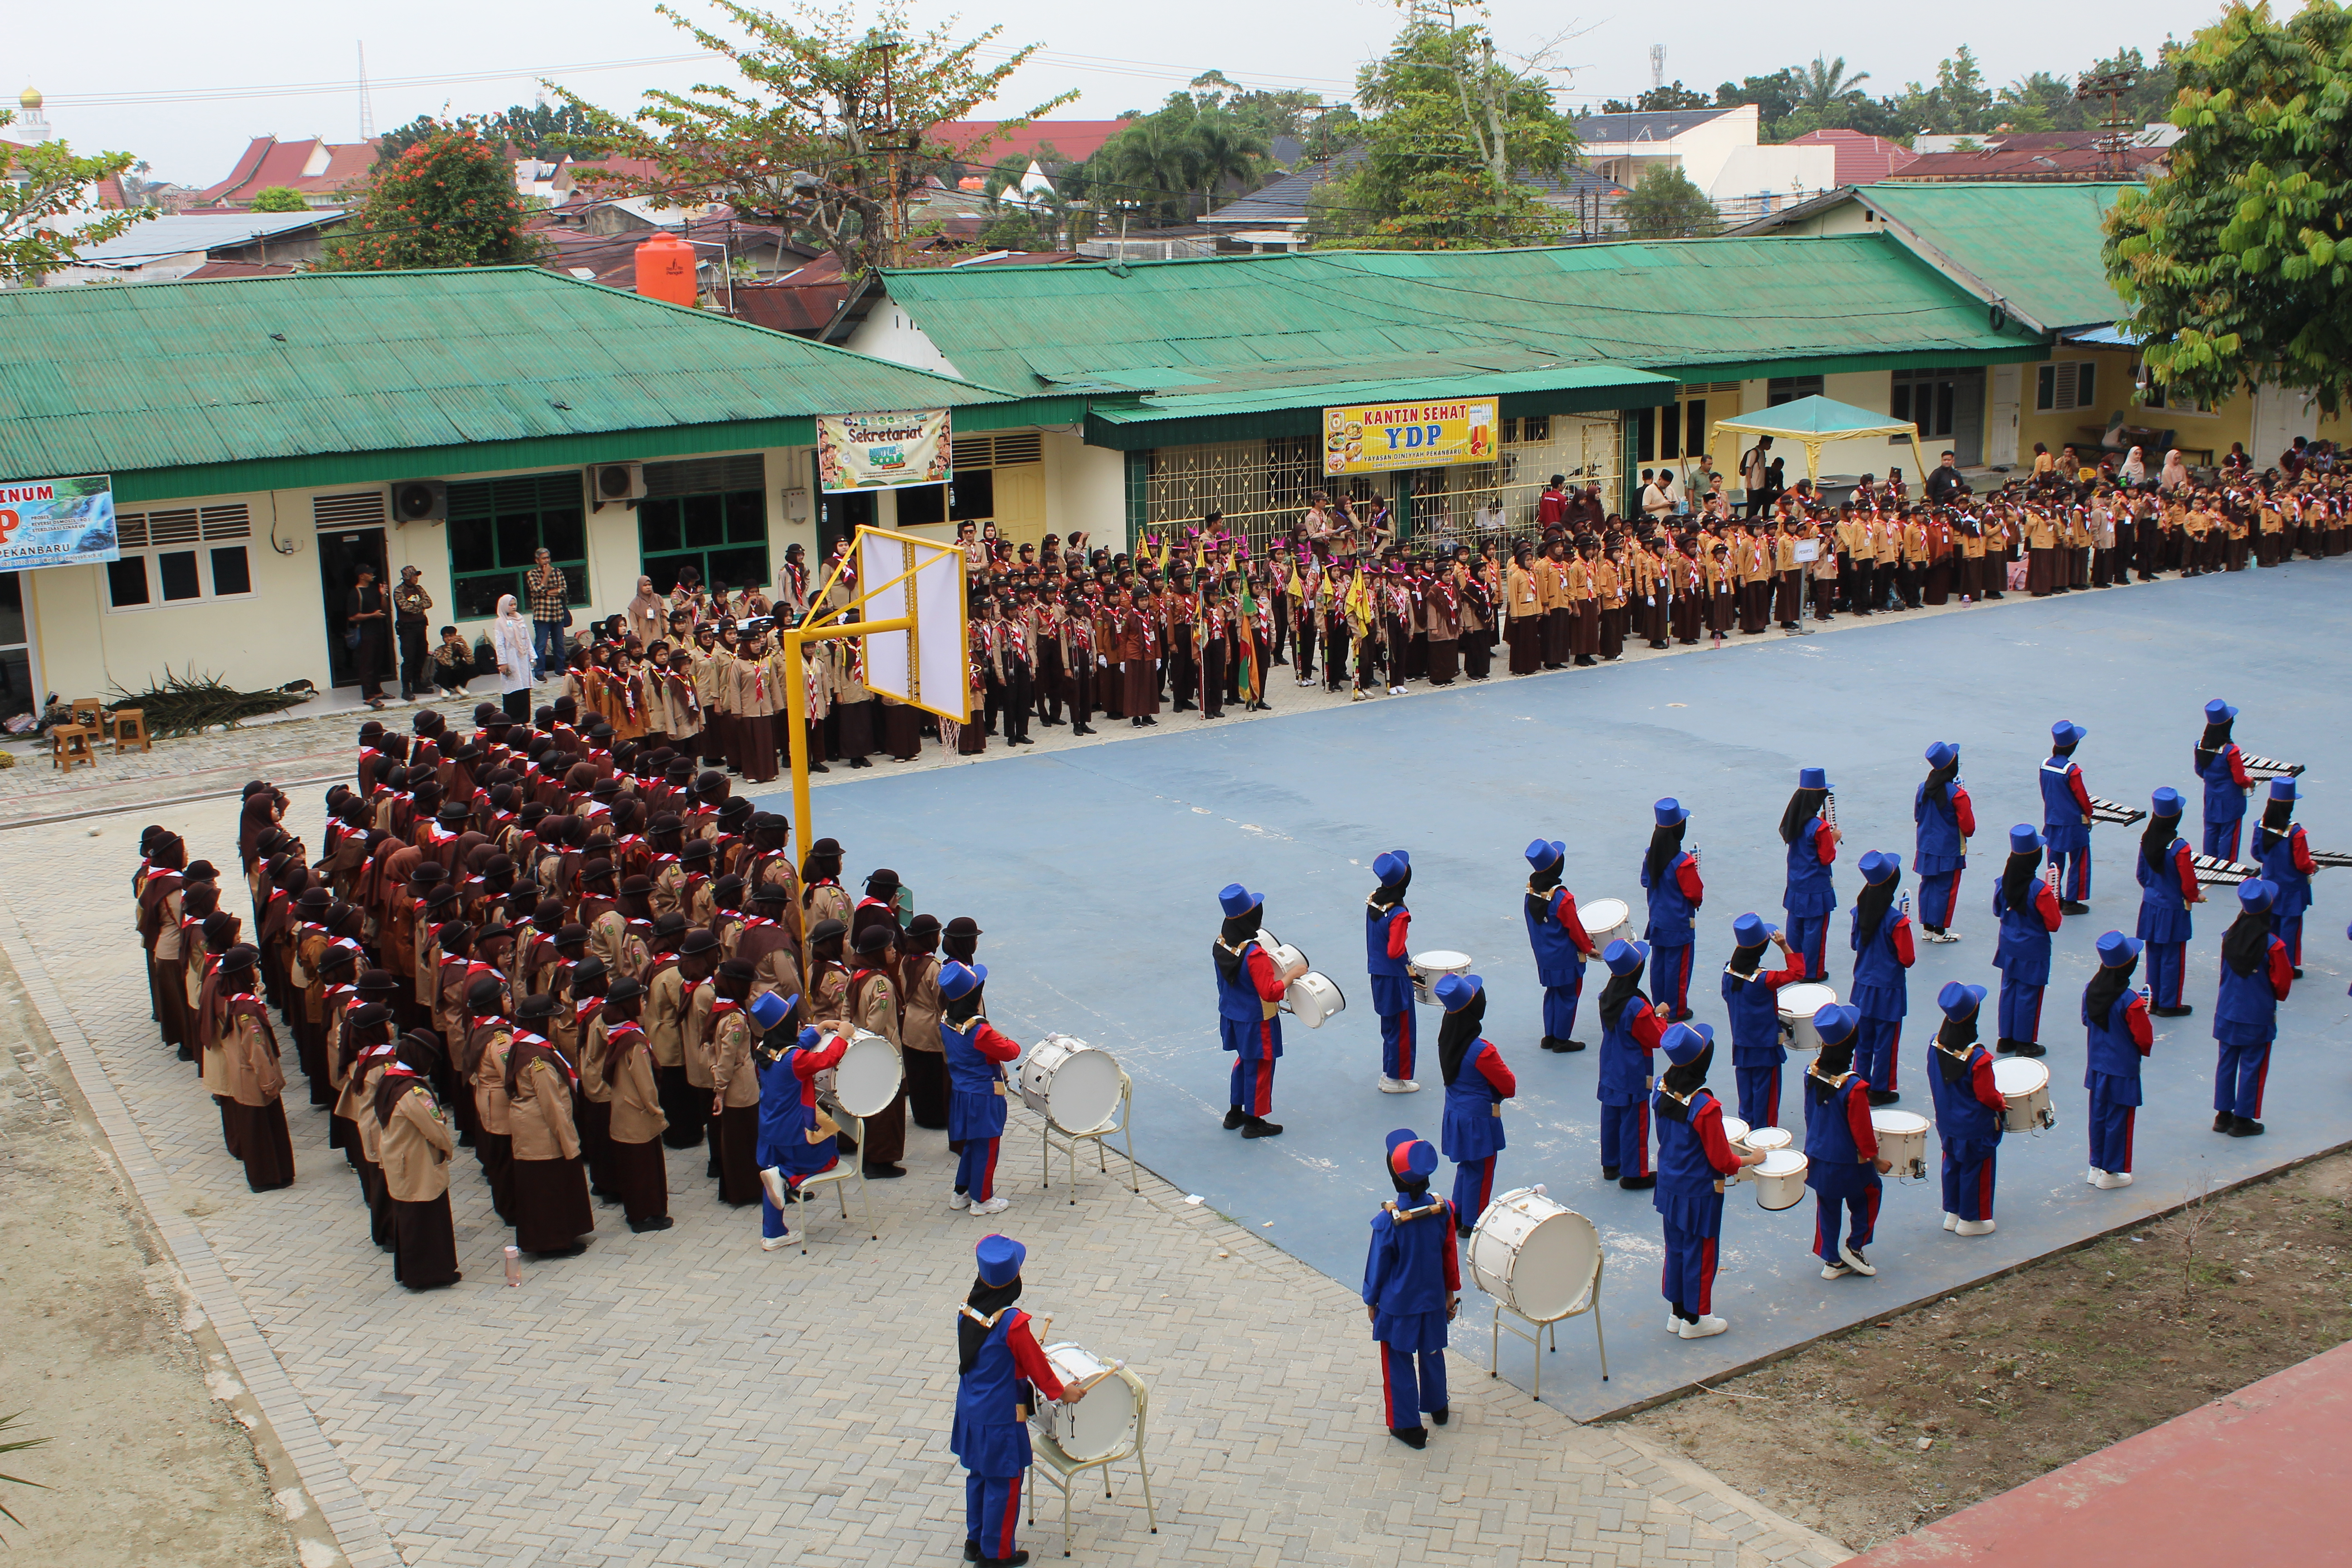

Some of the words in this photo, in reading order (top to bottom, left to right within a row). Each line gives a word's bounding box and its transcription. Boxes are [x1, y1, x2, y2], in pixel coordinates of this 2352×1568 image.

[1364, 408, 1418, 425] KANTIN
[1424, 405, 1466, 421] SEHAT
[848, 425, 924, 443] Sekretariat
[1385, 425, 1442, 449] YDP
[1426, 449, 1461, 457] PEKANBARU
